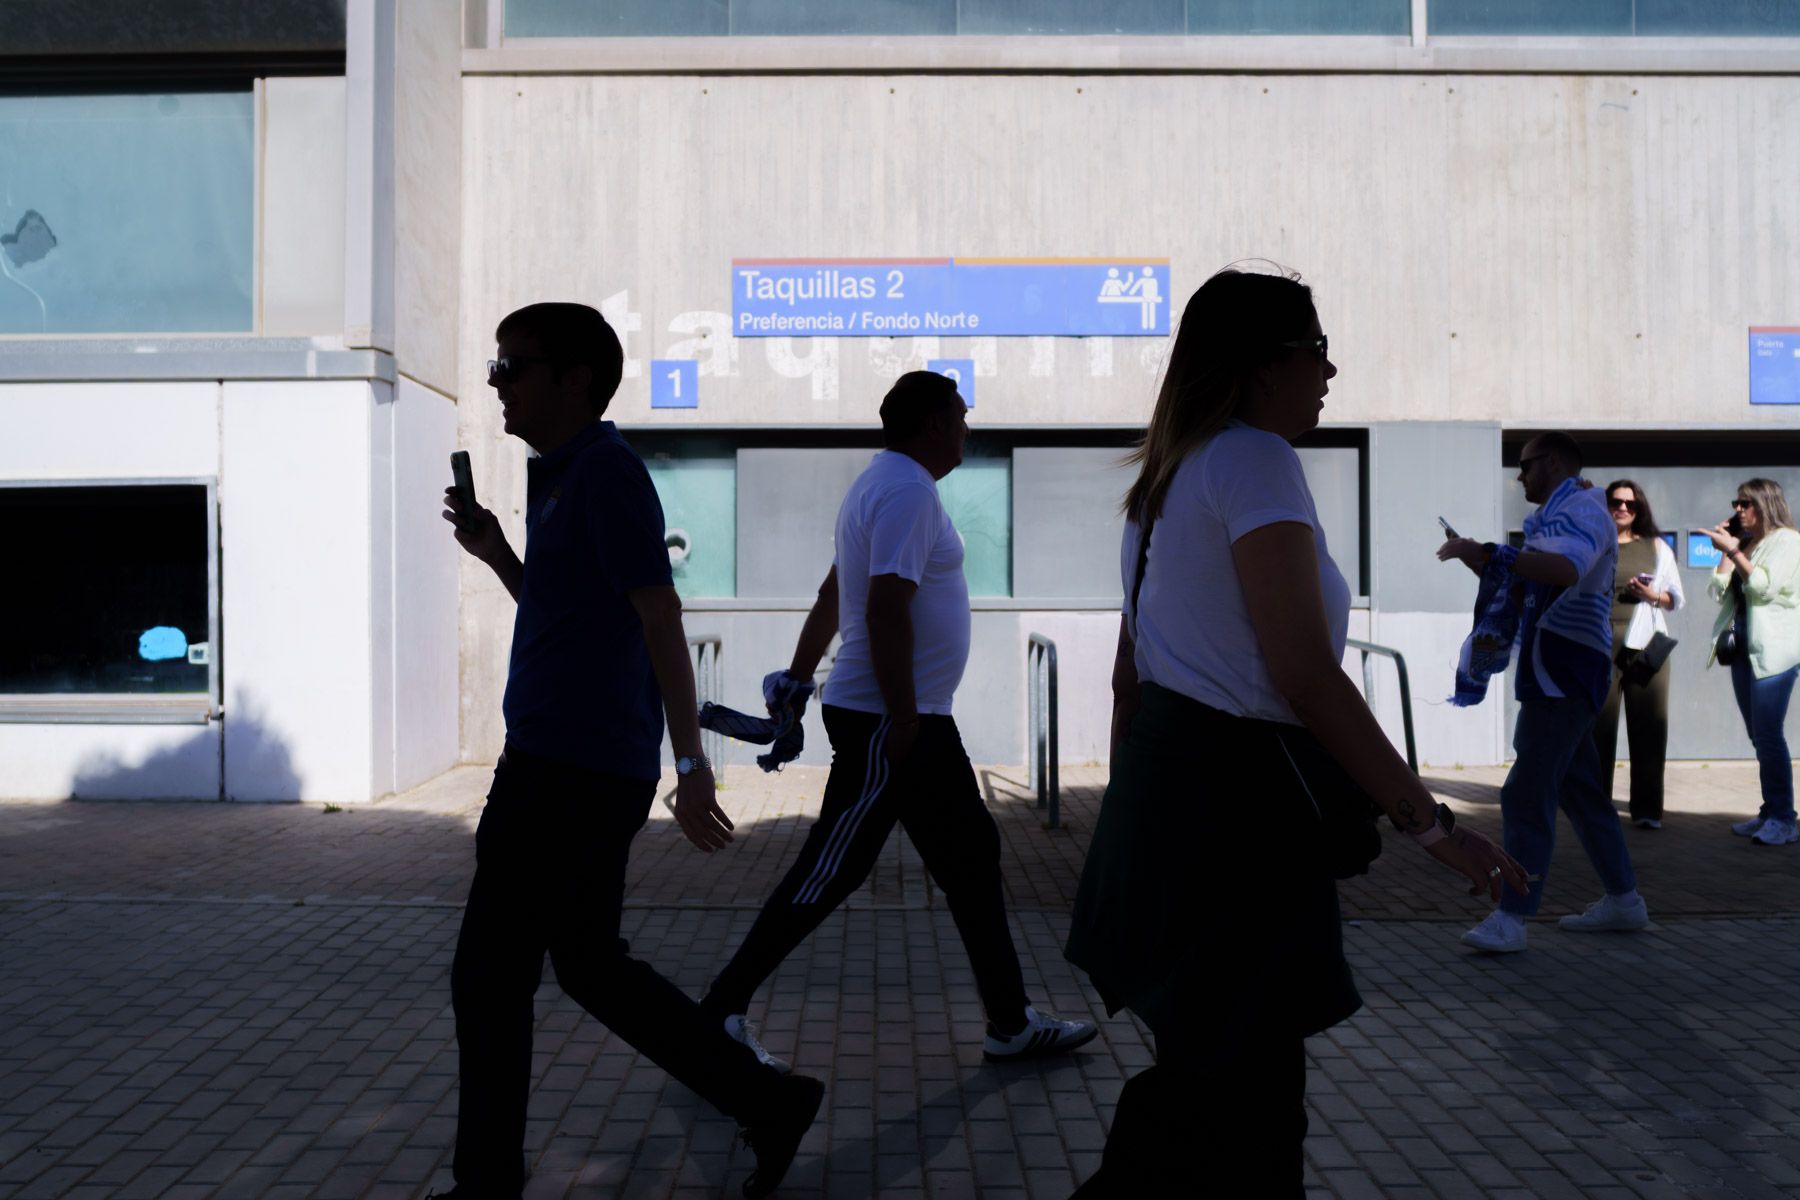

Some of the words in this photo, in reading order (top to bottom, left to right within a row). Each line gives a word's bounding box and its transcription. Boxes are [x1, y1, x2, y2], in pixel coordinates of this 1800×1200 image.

[739, 270, 876, 305] Taquillas
[886, 270, 905, 298] 2
[740, 311, 844, 330] Preferencia
[848, 312, 857, 329] /
[861, 311, 921, 329] Fondo
[924, 311, 980, 328] Norte
[667, 368, 682, 398] 1
